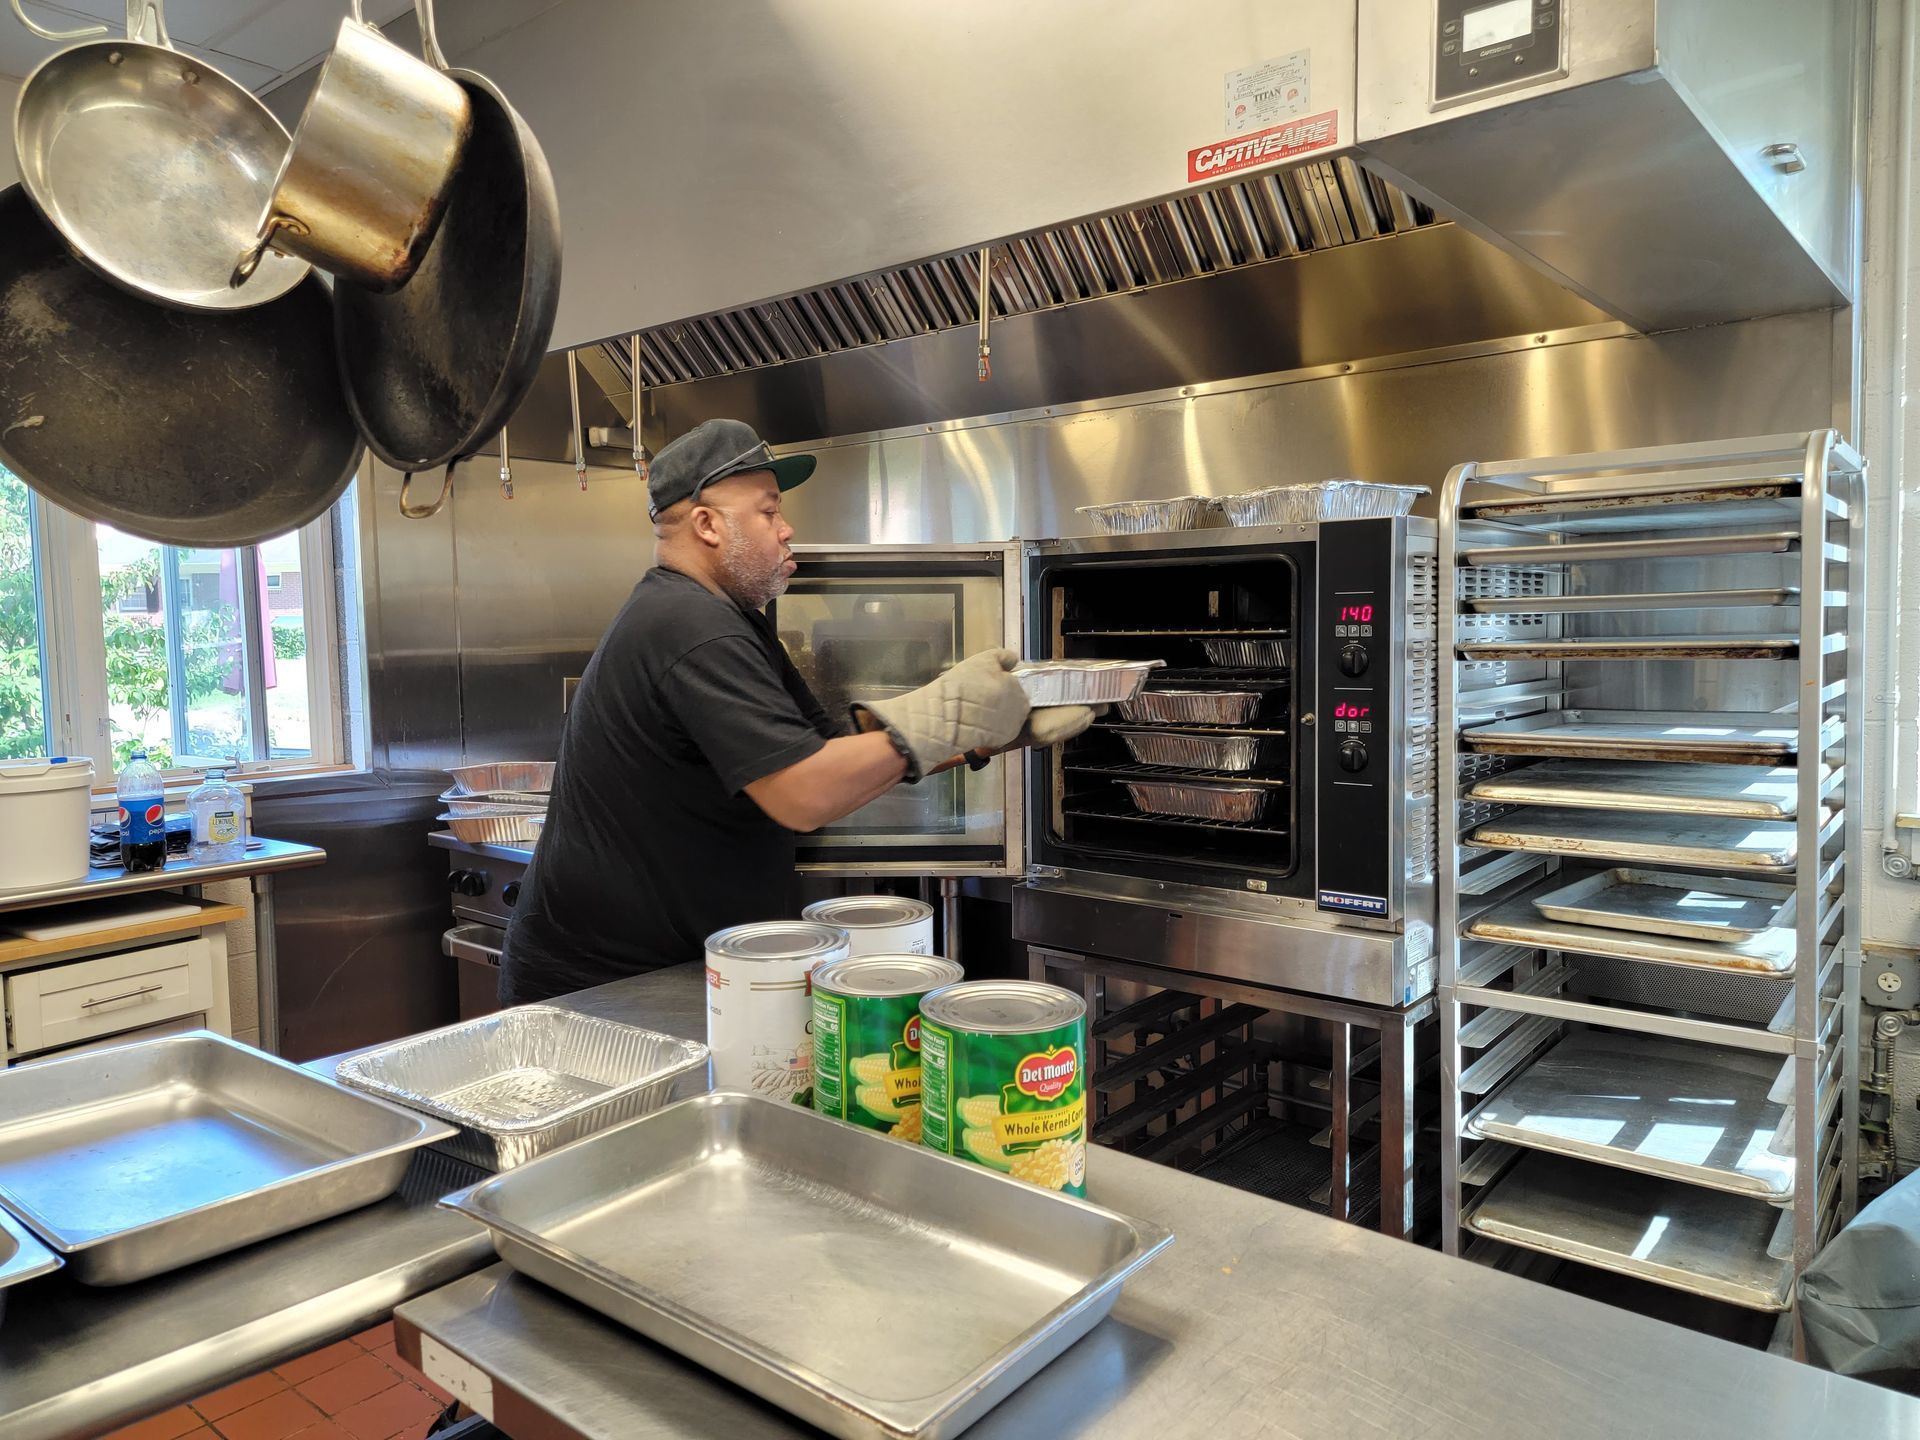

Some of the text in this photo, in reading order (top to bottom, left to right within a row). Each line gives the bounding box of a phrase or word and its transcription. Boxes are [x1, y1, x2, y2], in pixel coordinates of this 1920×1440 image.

[1253, 86, 1281, 102] TITAN
[1195, 119, 1331, 173] CAPTIVEAIRE
[1341, 605, 1372, 622] 140
[1335, 702, 1369, 718] dor
[148, 828, 165, 836] peps
[1321, 895, 1383, 909] MOFFAT
[486, 953, 501, 967] VUL
[1022, 1060, 1074, 1083] Del Monte
[894, 1077, 921, 1090] Whol
[1039, 1080, 1063, 1093] Quality
[1004, 1121, 1040, 1136] Whole
[1042, 1113, 1070, 1133] Kernel
